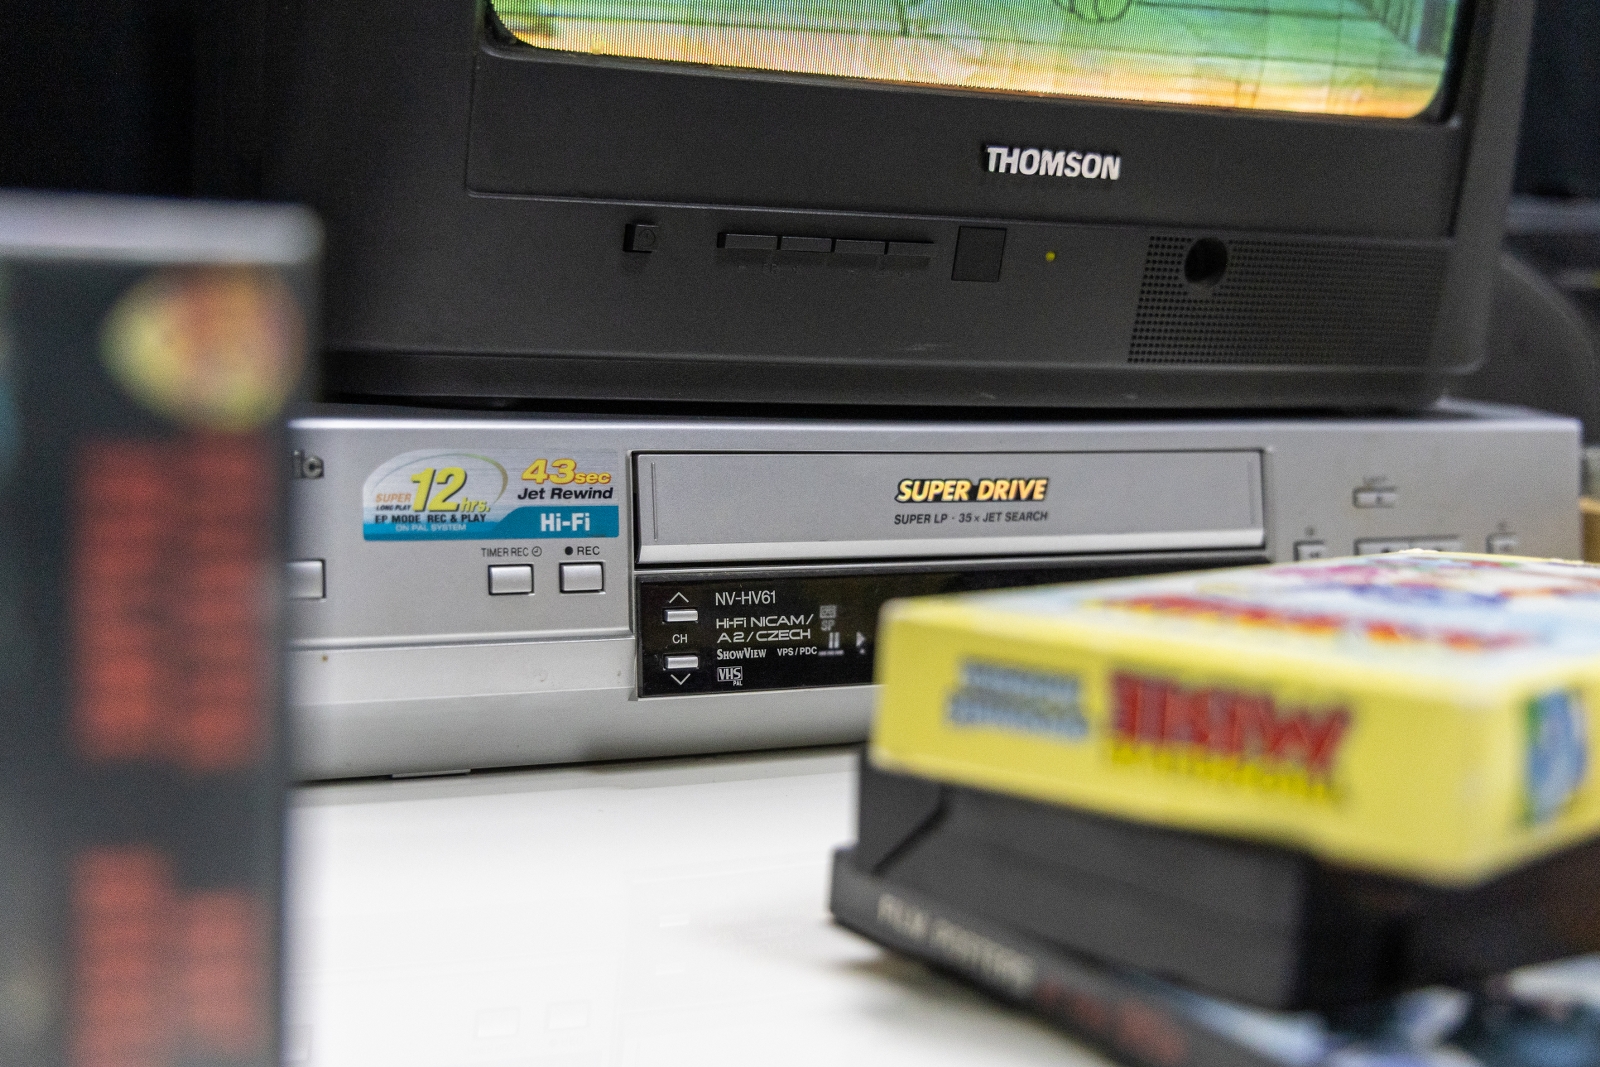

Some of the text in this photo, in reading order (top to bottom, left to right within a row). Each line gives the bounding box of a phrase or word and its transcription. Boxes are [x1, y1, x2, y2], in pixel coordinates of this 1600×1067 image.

[987, 146, 1121, 181] THOMSON
[517, 487, 613, 500] Jet Rewind
[897, 478, 1048, 502] SUPER DRIVE
[375, 493, 412, 503] SUPER
[375, 513, 487, 523] EP MODE REC & PLAY
[540, 512, 591, 532] Hi-Fi
[894, 513, 931, 525] SUPER
[933, 513, 948, 524] LP
[982, 512, 1002, 523] JET
[1004, 510, 1049, 522] SEARCH
[395, 523, 467, 532] ON PAL SYSTEM
[481, 547, 529, 557] TIMER REC
[576, 546, 601, 556] REC
[715, 590, 776, 606] NV-HV61
[672, 633, 688, 644] CH
[718, 667, 742, 681] VHS
